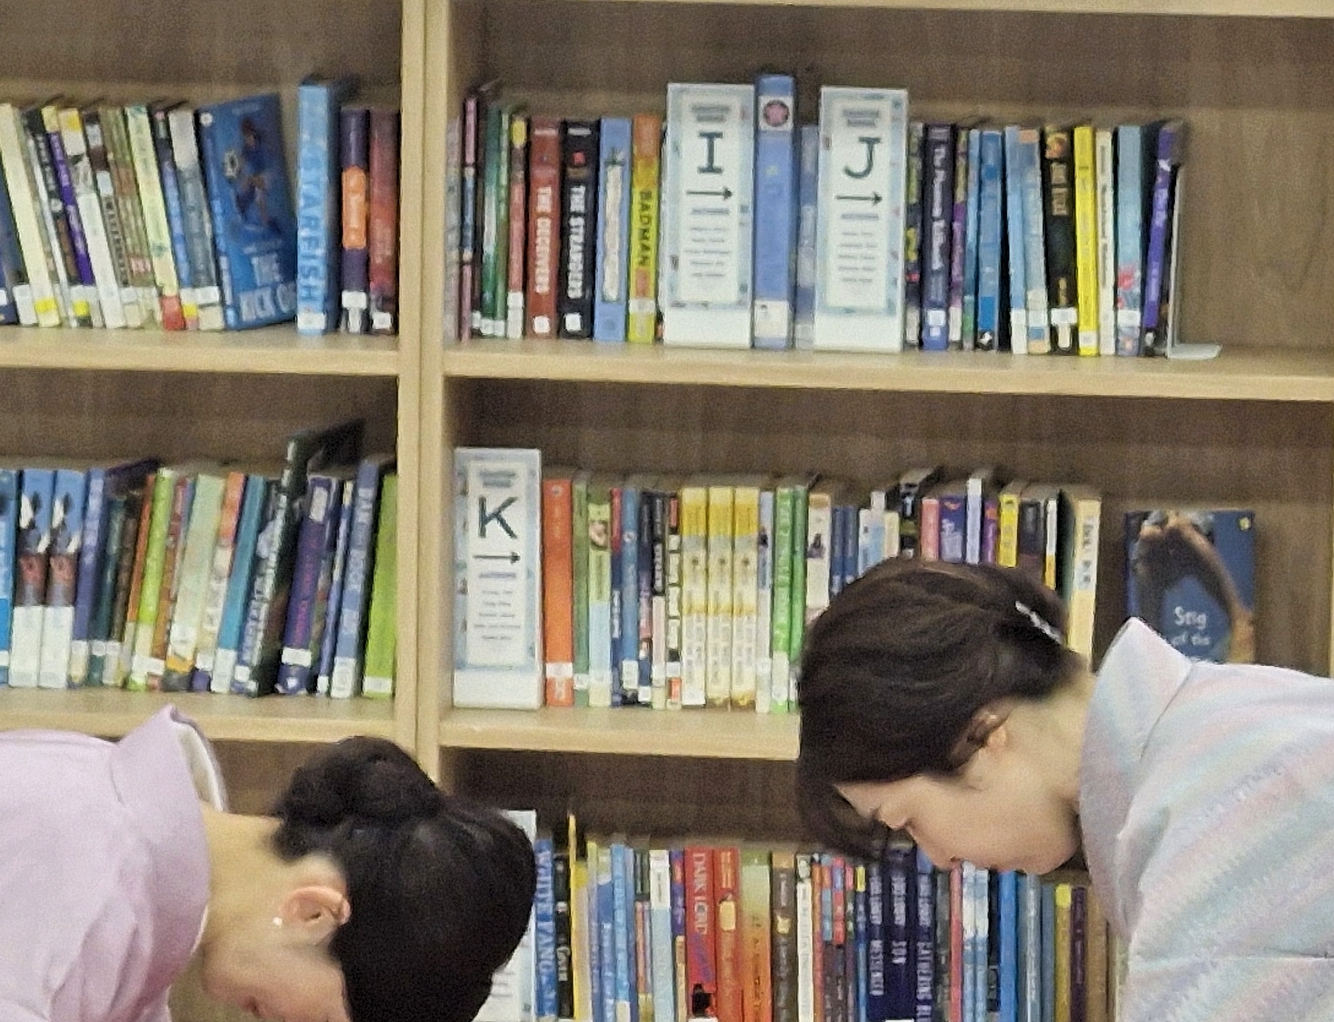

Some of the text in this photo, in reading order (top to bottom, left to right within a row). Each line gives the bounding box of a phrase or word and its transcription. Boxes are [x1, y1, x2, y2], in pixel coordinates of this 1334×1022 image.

[697, 131, 724, 174] I
[842, 136, 881, 180] J
[535, 186, 552, 213] THE
[569, 186, 586, 213] THE
[299, 158, 324, 303] STARFISH
[639, 191, 653, 267] BADMAN
[478, 496, 519, 539] K
[1174, 606, 1207, 628] Stig
[536, 850, 554, 973] WHITE FANG
[693, 853, 708, 935] DARK LORD
[892, 941, 906, 965] SON
